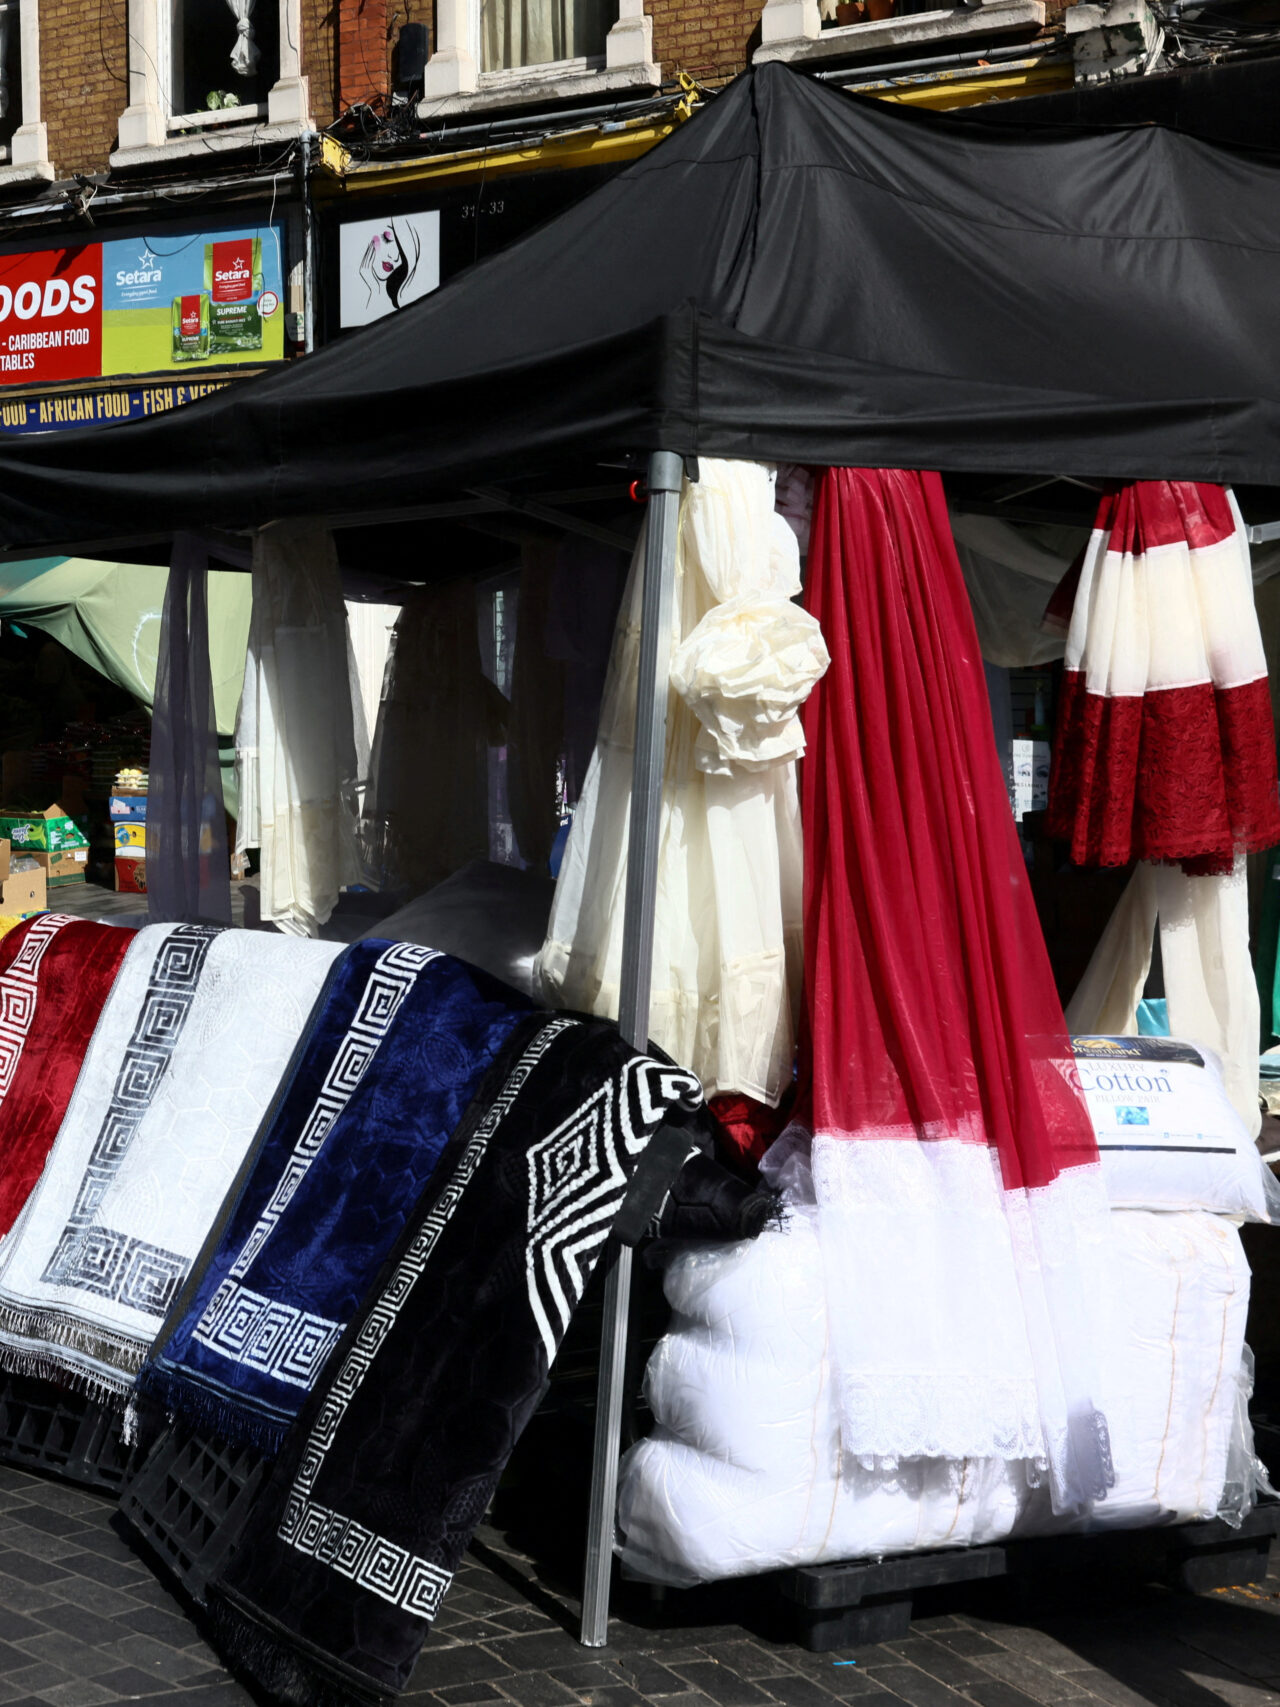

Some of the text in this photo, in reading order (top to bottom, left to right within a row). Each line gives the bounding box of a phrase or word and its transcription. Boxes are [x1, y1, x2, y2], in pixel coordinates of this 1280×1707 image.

[489, 201, 505, 215] 33
[116, 268, 162, 287] Setara
[215, 269, 250, 282] Setara
[216, 306, 248, 316] SUPREME
[8, 330, 62, 351] CARIBBEAN
[64, 328, 90, 346] FOOD
[39, 394, 93, 424] AFRICAN
[96, 391, 130, 418] FOOD
[142, 387, 174, 415] FISH
[177, 386, 187, 405] &
[1089, 1062, 1145, 1073] LUXURY
[1069, 1067, 1173, 1093] Cotton
